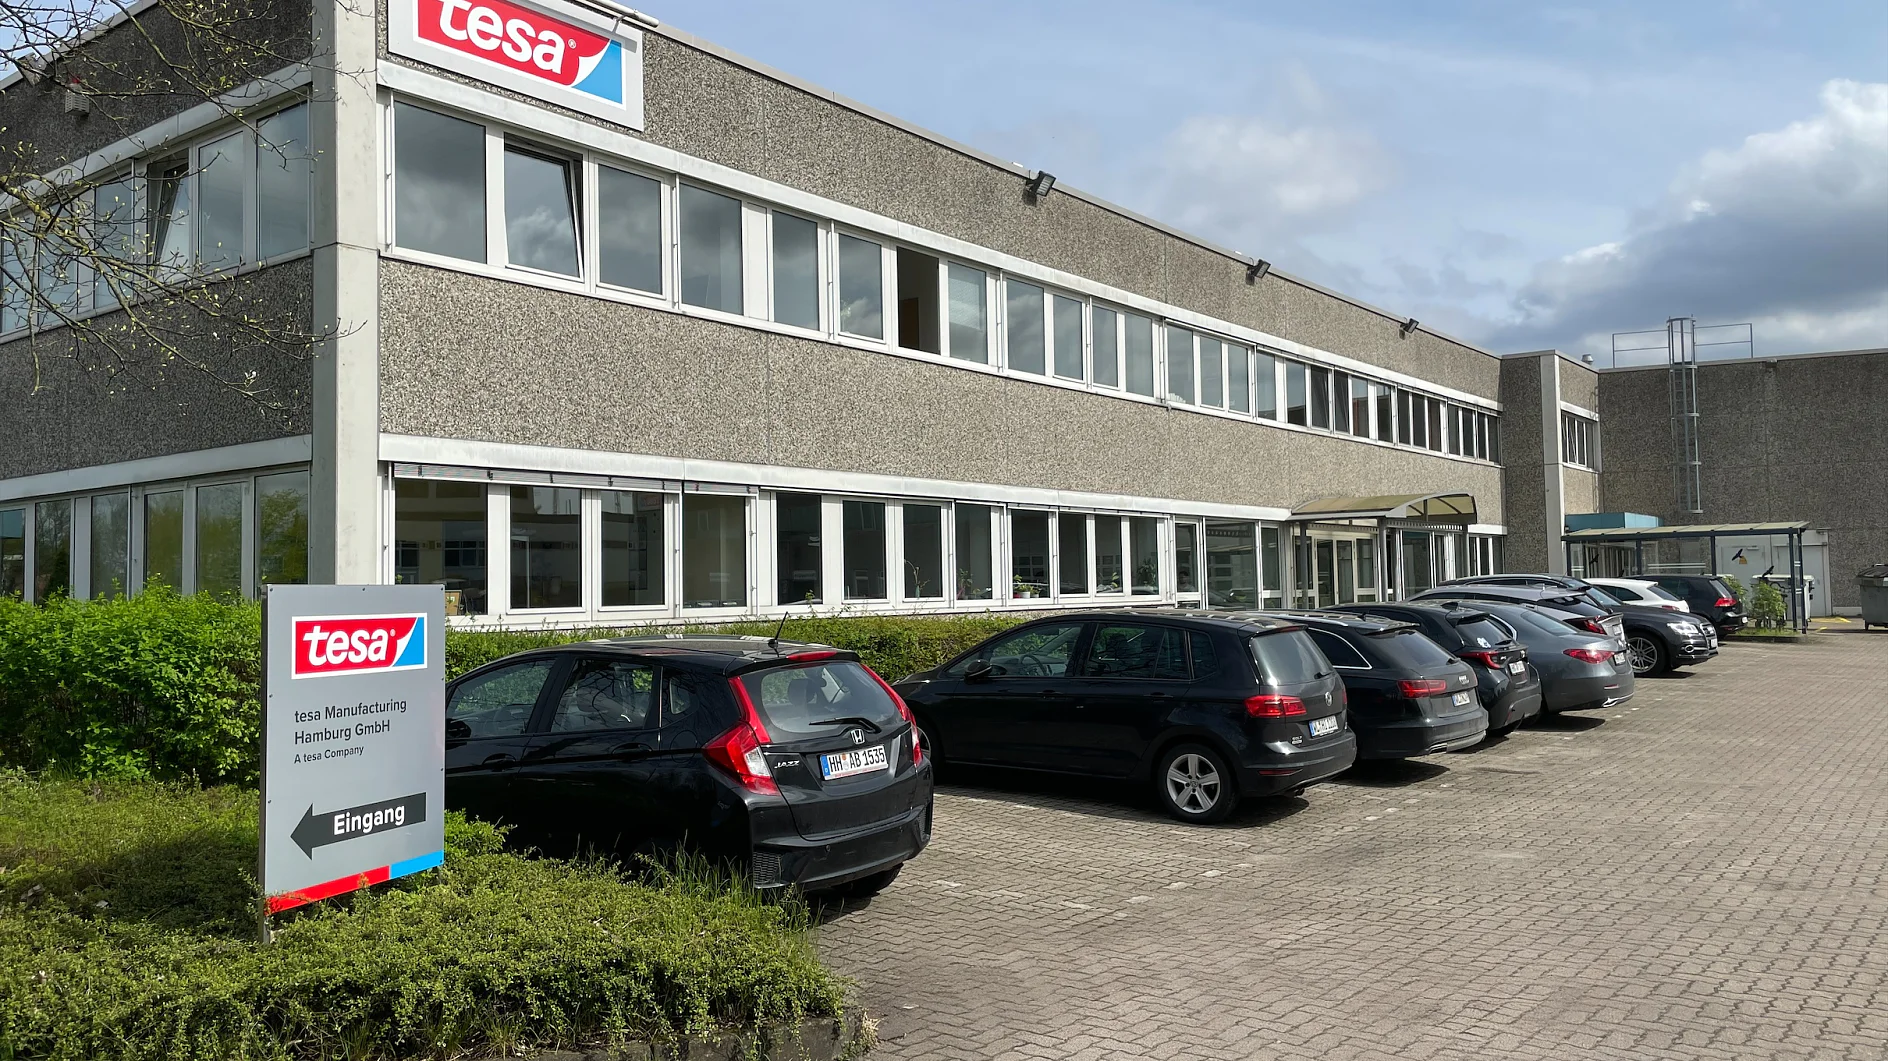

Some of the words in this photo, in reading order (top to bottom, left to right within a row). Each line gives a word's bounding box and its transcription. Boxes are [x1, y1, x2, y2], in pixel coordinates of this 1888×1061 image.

[439, 0, 566, 74] tesa
[303, 625, 388, 666] tesa
[294, 708, 321, 723] tesa
[325, 699, 407, 719] Manufacturing
[294, 726, 351, 744] Hamburg
[355, 720, 390, 736] GmbH
[294, 753, 301, 764] A
[303, 752, 322, 763] tesa
[324, 746, 364, 759] Company
[774, 760, 799, 768] JAZZ
[828, 756, 843, 772] HH
[849, 751, 861, 768] AB
[863, 748, 884, 766] 1535
[333, 805, 405, 835] Eingang
